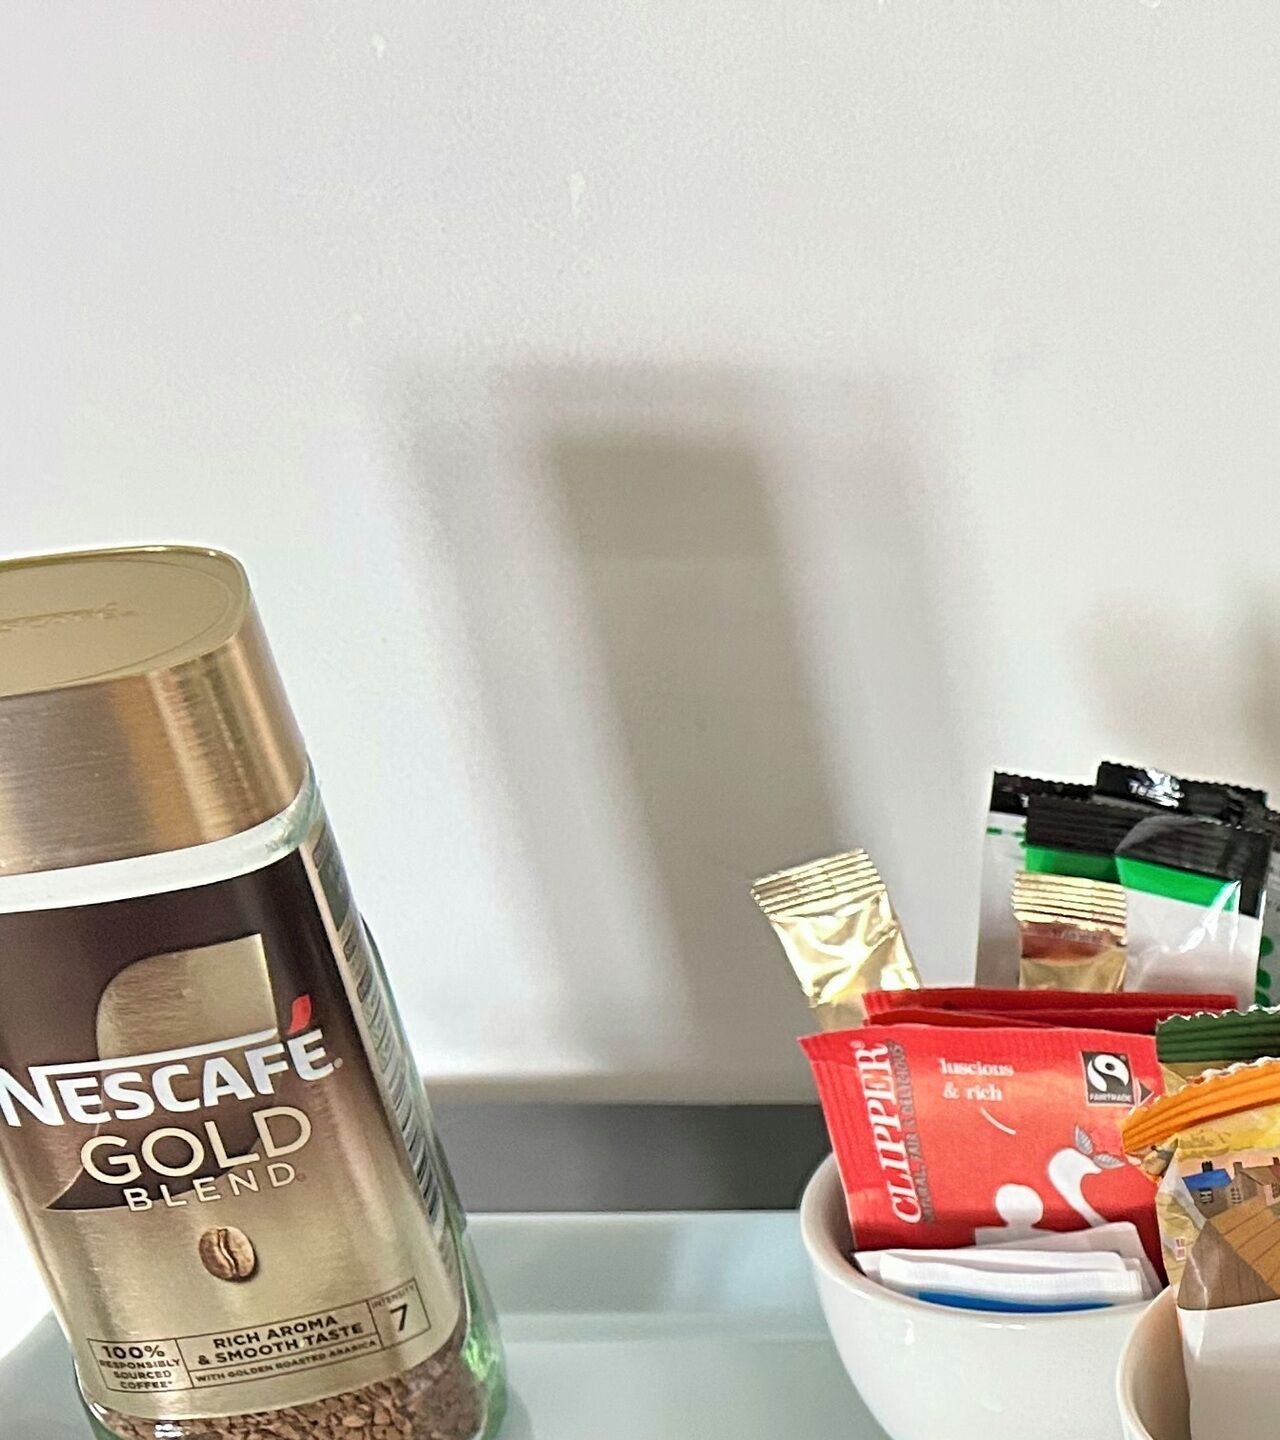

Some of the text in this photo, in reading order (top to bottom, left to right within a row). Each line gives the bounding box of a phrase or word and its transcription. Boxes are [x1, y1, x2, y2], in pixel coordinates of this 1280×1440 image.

[938, 1058, 1014, 1077] luscious
[943, 1082, 1003, 1101] & rich
[81, 1106, 312, 1185] GOLD
[855, 1042, 922, 1224] CLIPPER
[124, 1163, 296, 1213] BLEND
[213, 1315, 338, 1349] RICH AROMA
[390, 1303, 408, 1331] 7
[101, 1345, 165, 1359] 100%
[198, 1323, 364, 1365] & SMOOTH TASTE
[99, 1359, 180, 1369] RESPONSIBLY
[113, 1370, 171, 1380] SOURCED
[195, 1340, 376, 1383] WITH GOLDEN ROASTED ARABICA
